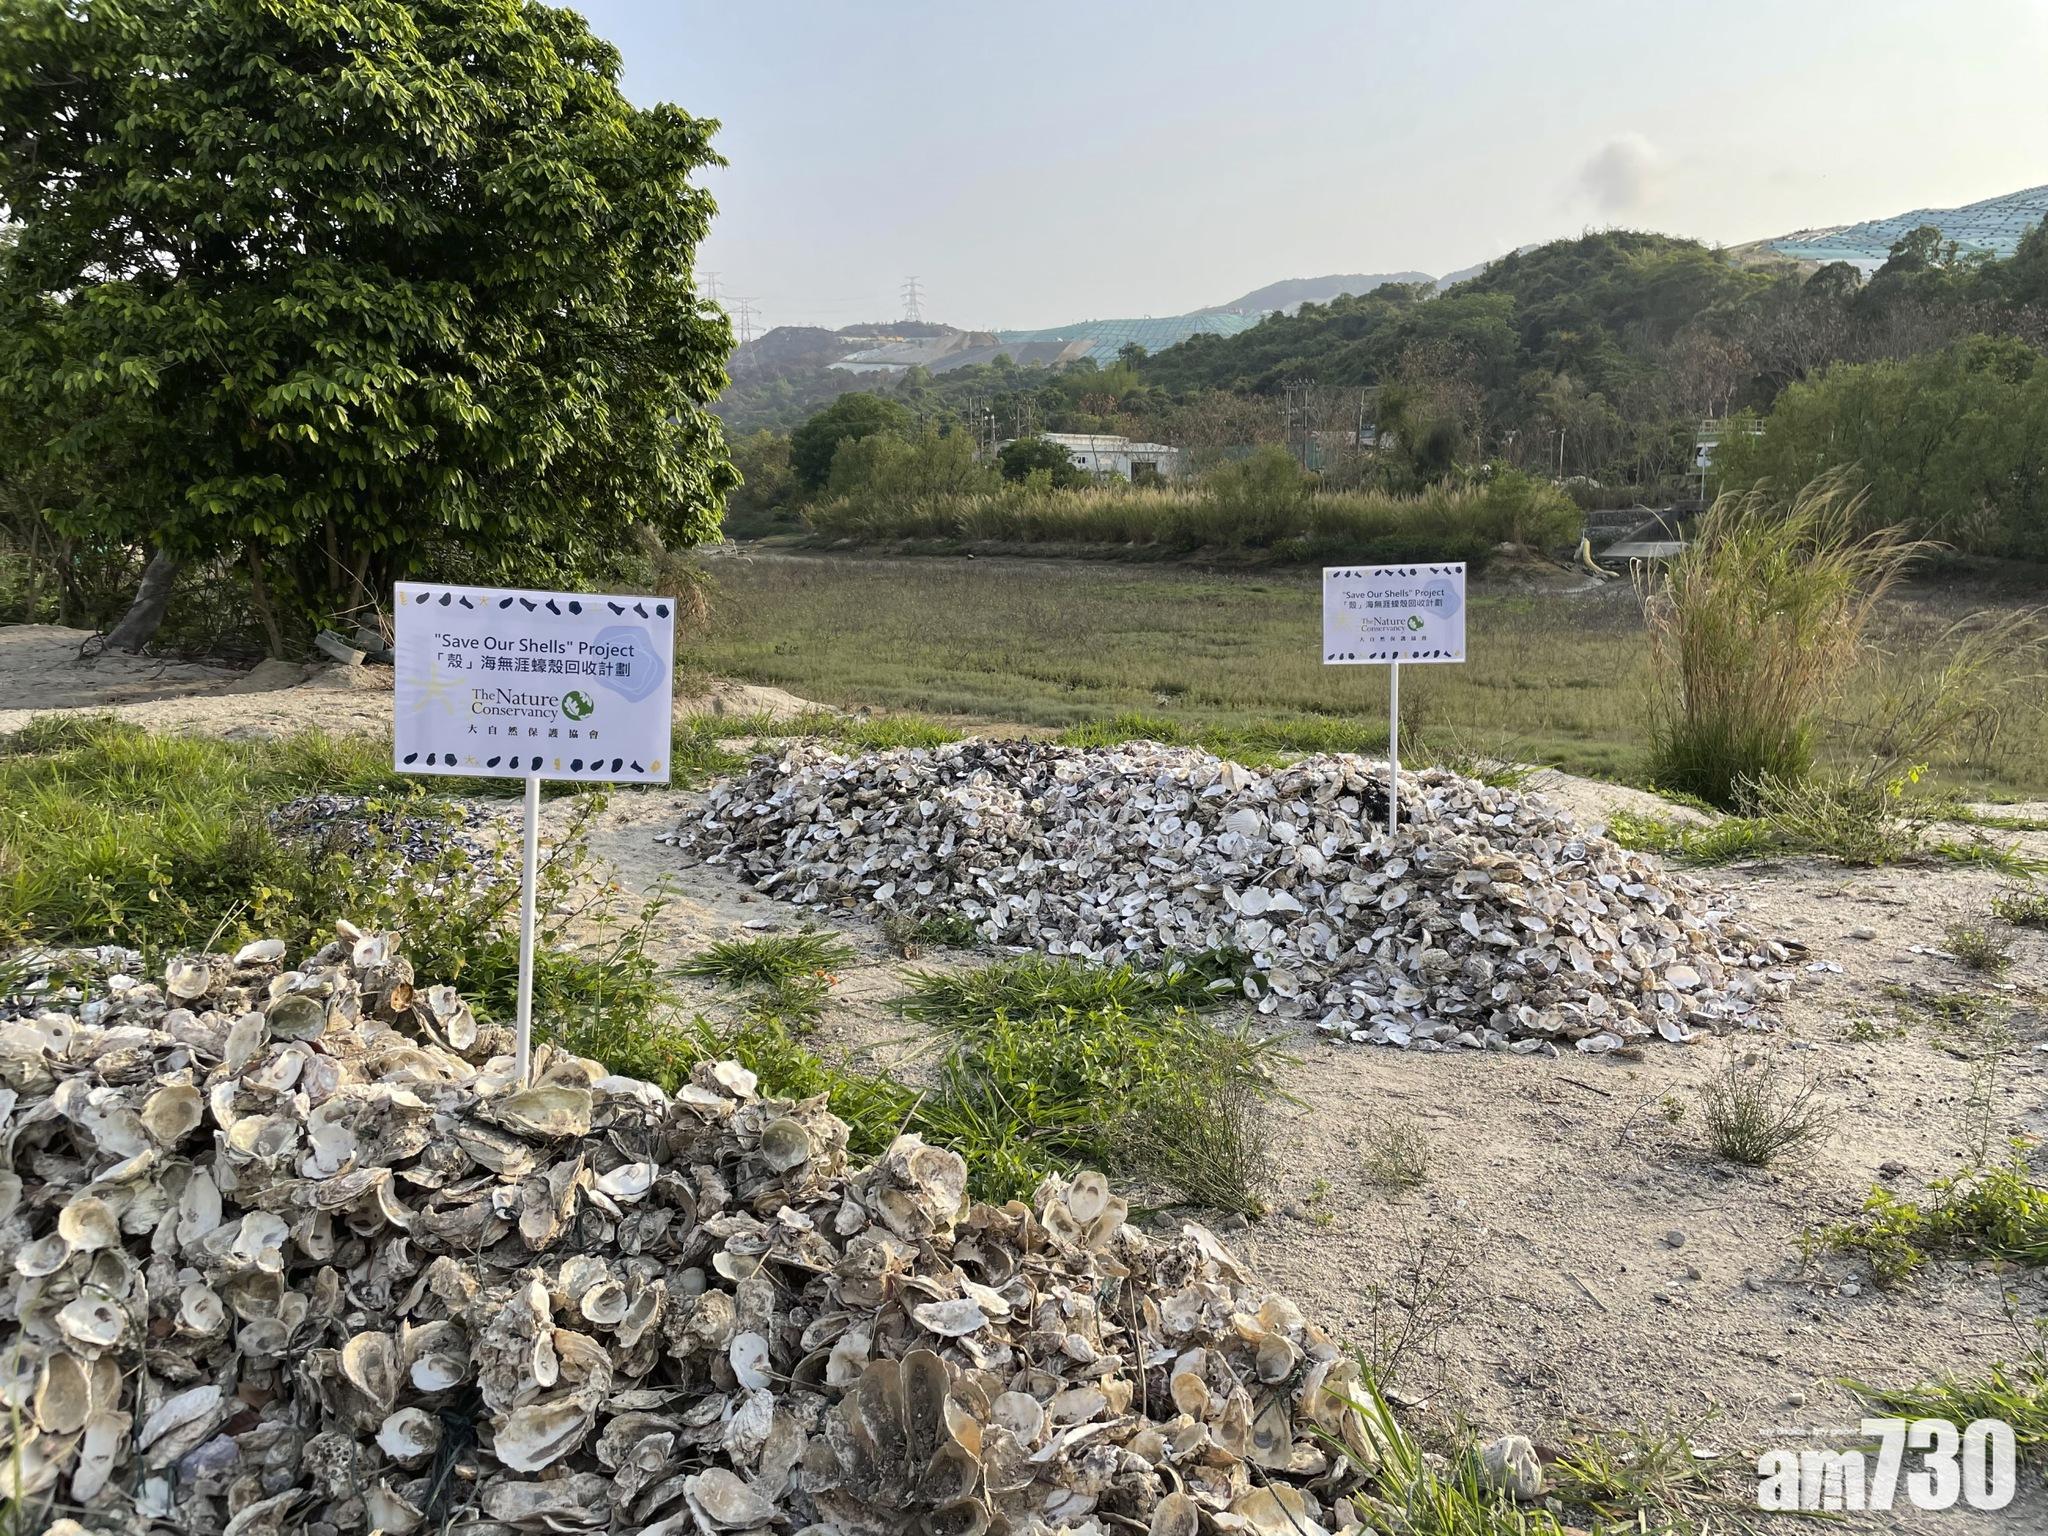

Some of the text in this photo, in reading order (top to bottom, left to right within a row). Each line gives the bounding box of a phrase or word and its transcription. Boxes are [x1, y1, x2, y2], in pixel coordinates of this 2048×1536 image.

[1415, 588, 1445, 598] Project
[1374, 616, 1406, 625] Nature
[1361, 624, 1406, 633] Conservancy
[434, 633, 635, 660] "Save Our Shells" Project
[471, 687, 559, 708] The Nature
[471, 701, 559, 723] Conservancy
